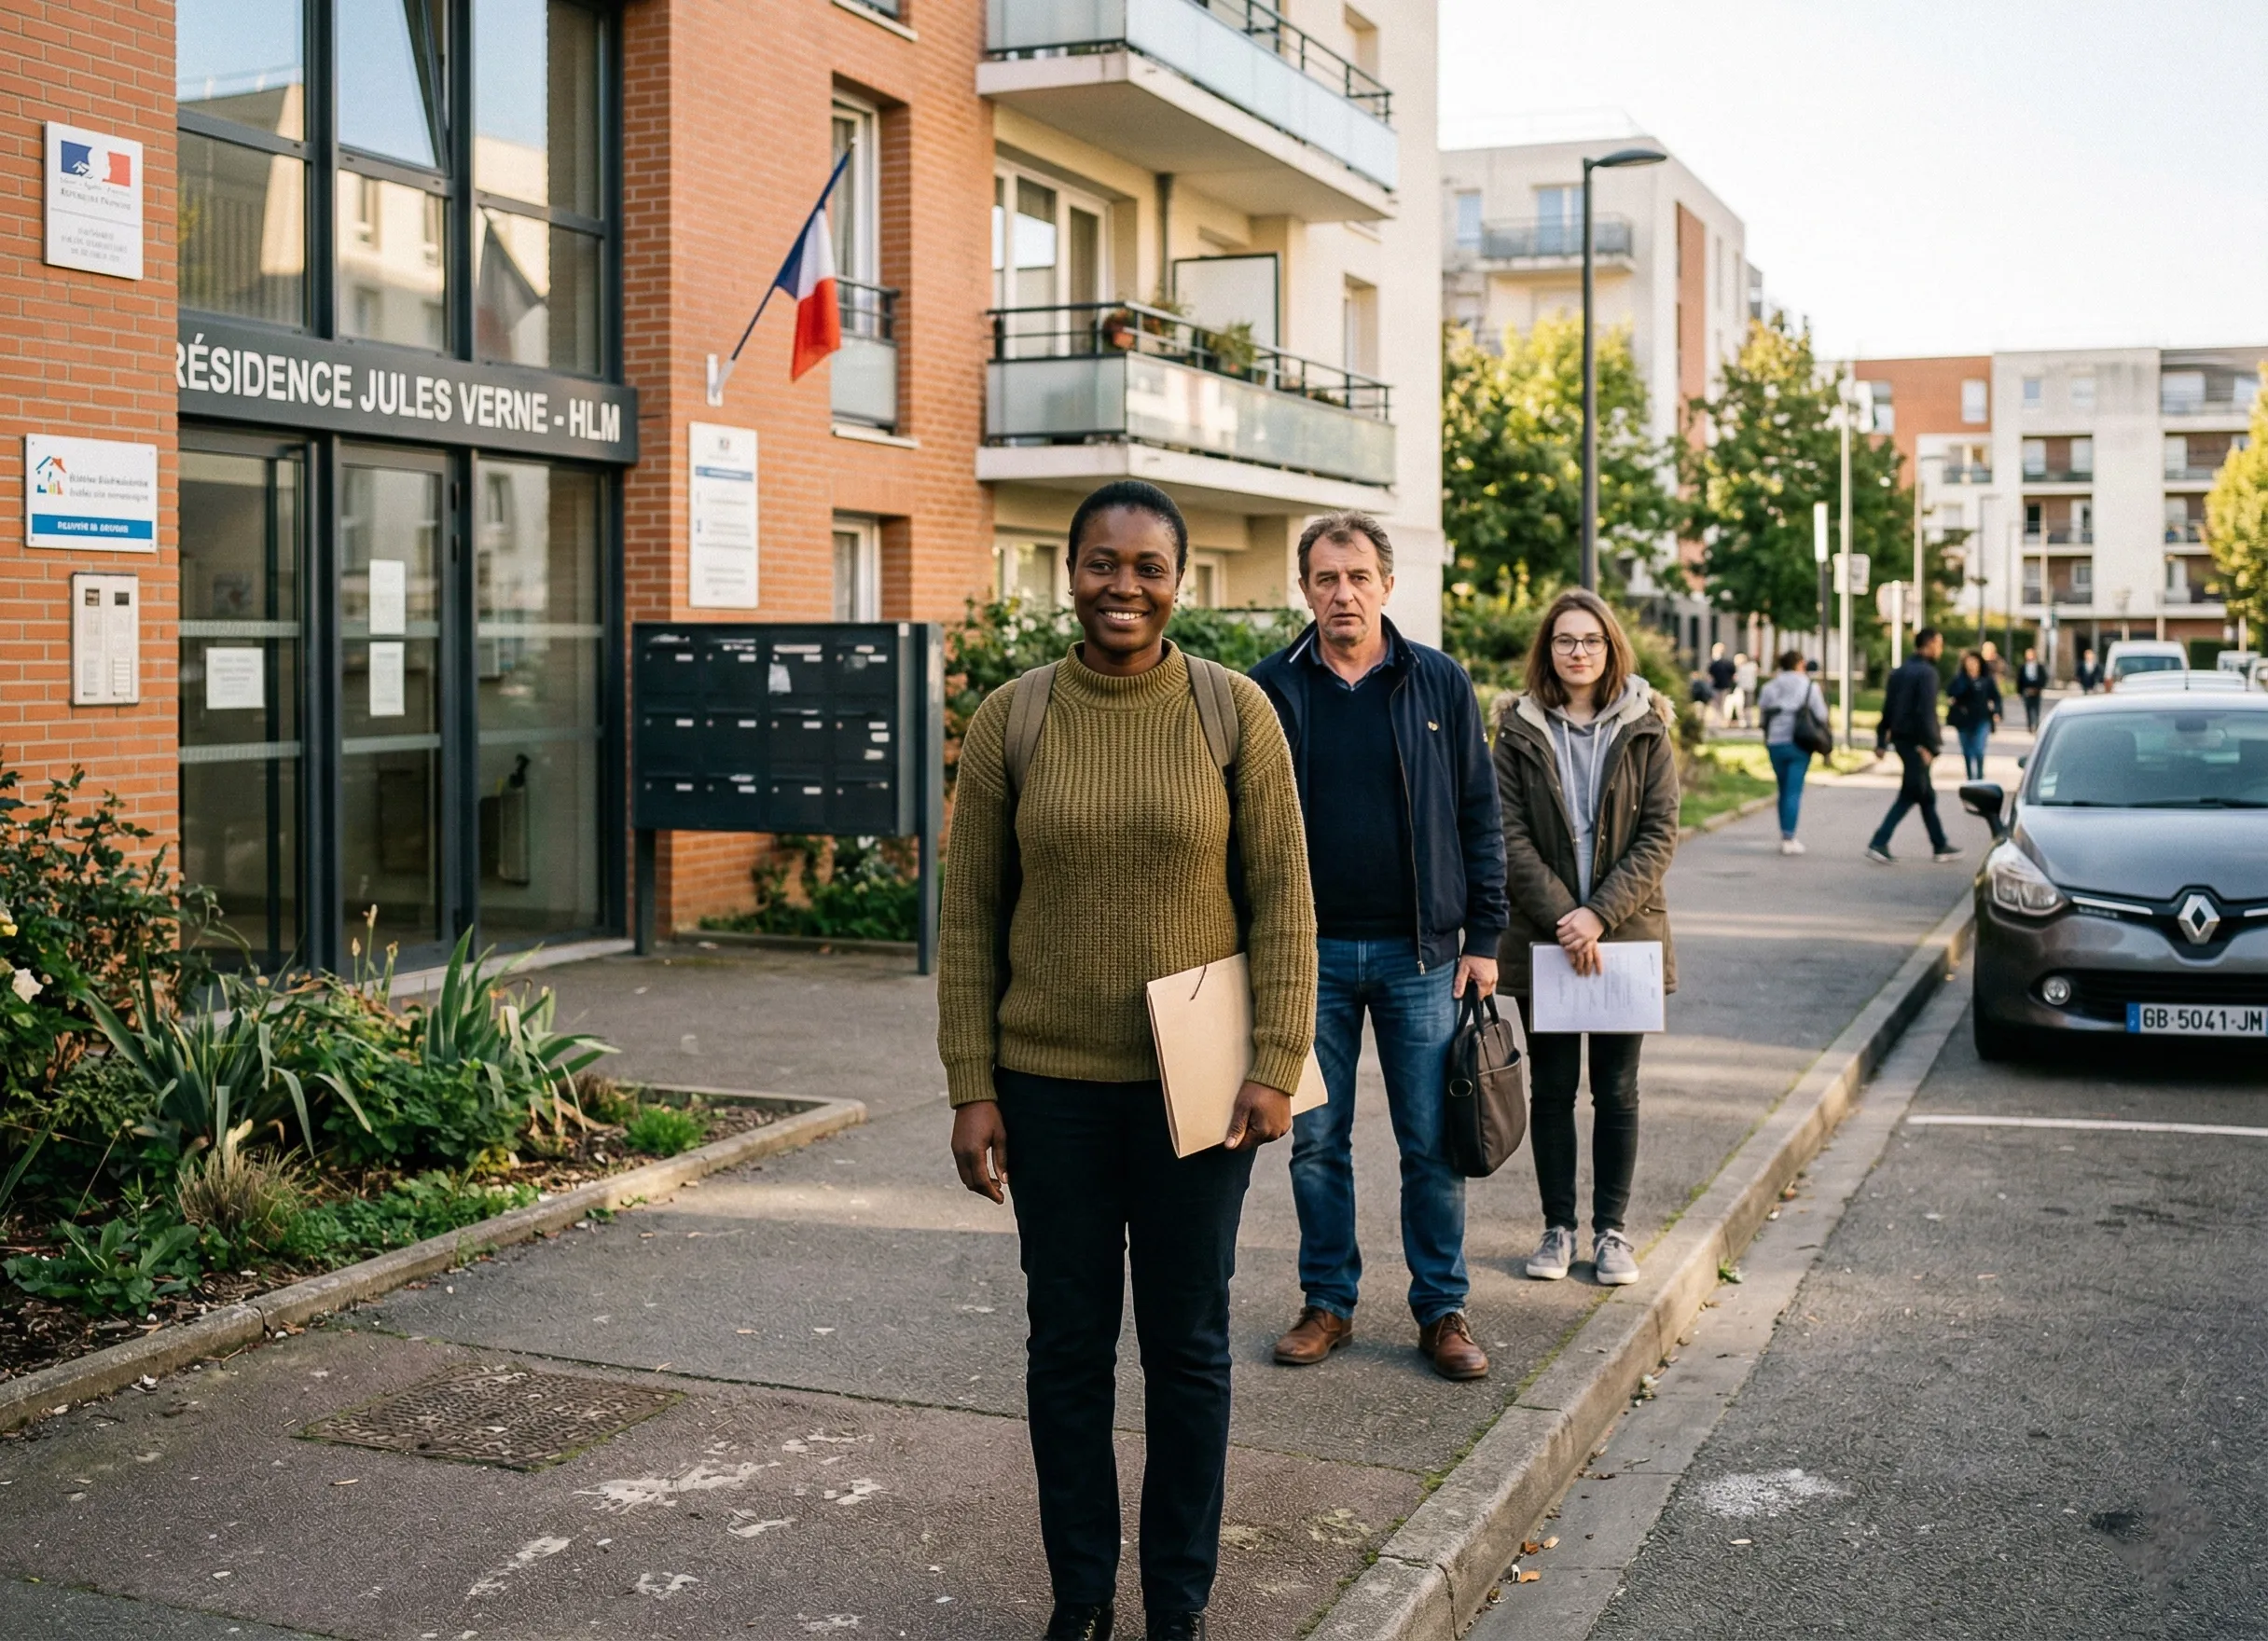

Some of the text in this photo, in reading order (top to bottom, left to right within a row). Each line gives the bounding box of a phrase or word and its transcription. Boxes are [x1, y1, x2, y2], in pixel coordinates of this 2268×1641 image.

[359, 368, 453, 422] JULES
[458, 382, 548, 434] VERNE
[569, 397, 621, 444] HLM
